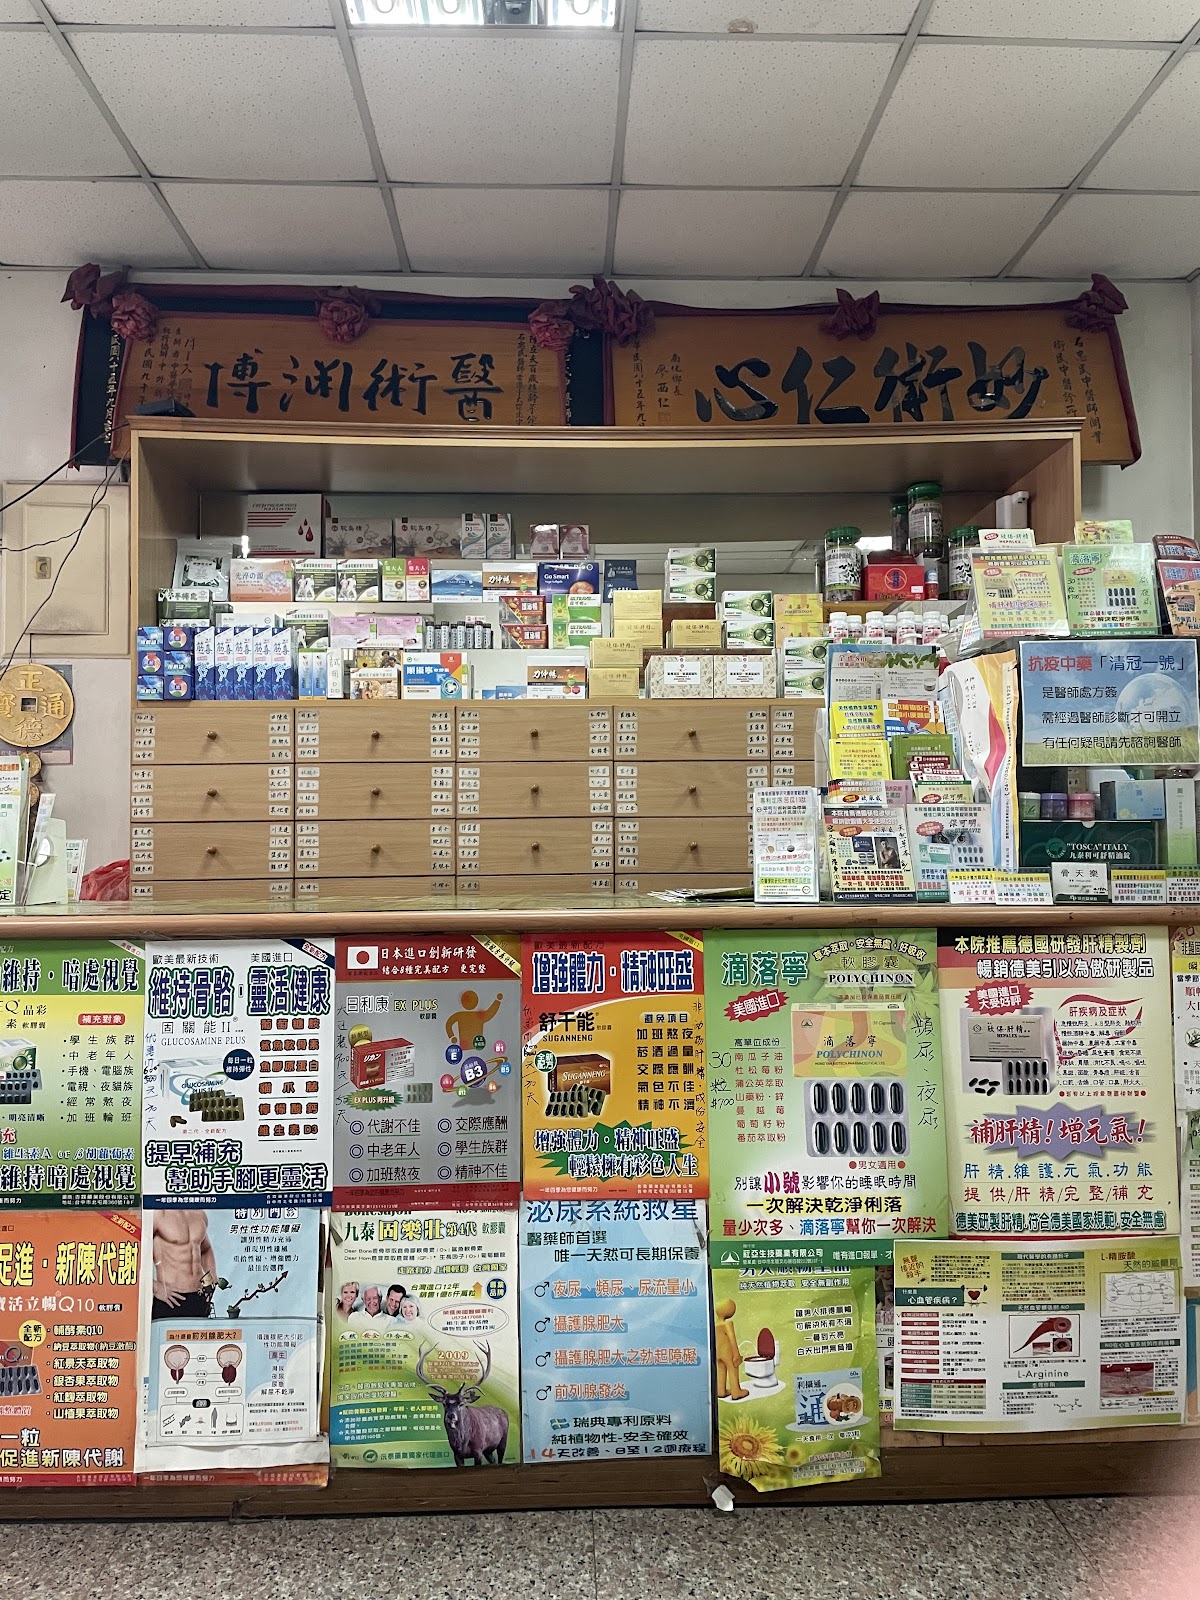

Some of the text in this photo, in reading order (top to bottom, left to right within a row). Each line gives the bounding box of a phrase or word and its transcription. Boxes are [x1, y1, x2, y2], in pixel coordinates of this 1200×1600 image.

[1028, 654, 1185, 672] 抗疫中藥「清冠一號」
[1042, 711, 1182, 724] 需經過醫師診斷才可開立
[1042, 737, 1182, 749] 有任何疑問請先諮詢醫師
[534, 940, 605, 949] 歐美最新配方
[954, 933, 1146, 954] 本院推薦德國研發肝精製劑
[251, 952, 293, 964] 美國進口
[302, 942, 328, 961] 全新配方
[381, 945, 478, 960] 日本進口創新研發
[152, 953, 219, 965] 歐美最新技術
[382, 964, 487, 975] 結合8種完美配方 更完整
[721, 951, 808, 987] 滴落寧
[977, 958, 1154, 979] 暢銷德美引以為傲研製品
[829, 973, 914, 983] POLYCHINON
[977, 985, 1019, 998] 美國進口
[393, 999, 406, 1012] EX
[412, 999, 438, 1011] PLUS
[732, 991, 779, 1018] 美國進口
[979, 996, 1022, 1010] 大受好評
[644, 1013, 688, 1023] 避免項目
[1069, 1006, 1127, 1017] 肝疾病及症狀
[82, 1014, 123, 1025] 補充對象
[260, 1018, 320, 1031] 葡萄糖胺
[161, 1021, 216, 1034] 固關能
[69, 1035, 135, 1045] 學生族群
[161, 1036, 246, 1046] GLUCOSAMINE PLUS
[637, 1028, 694, 1041] 加班熬夜
[259, 1039, 319, 1051] 鯊魚軟骨素
[734, 1038, 780, 1046] 高單位成份
[823, 1035, 877, 1048] 滴落寧
[69, 1050, 134, 1061] 中老年人
[495, 1045, 504, 1053] B1
[637, 1046, 694, 1058] 菸酒過量
[816, 1050, 883, 1059] POLYCHINON
[227, 1056, 254, 1065] 每日一粒
[451, 1052, 457, 1060] E
[709, 1051, 732, 1069] 30
[735, 1052, 783, 1061] 南瓜子油
[67, 1065, 134, 1077] 手機、電腦族
[226, 1066, 253, 1074] 維持彈性
[259, 1060, 319, 1072] 魚膠原蛋白
[464, 1066, 484, 1079] B3
[501, 1065, 510, 1073] B5
[637, 1063, 694, 1076] 交際應酬
[735, 1066, 783, 1074] 杜松莓粉
[67, 1081, 133, 1092] 電視、夜貓族
[259, 1081, 319, 1094] 貓爪藤
[637, 1081, 695, 1093] 氣色不佳
[735, 1079, 784, 1087] 蒲公英萃取
[66, 1096, 133, 1107] 經常熬夜
[637, 1099, 695, 1111] 精神不濟
[258, 1102, 319, 1115] 檸檬酸鈣
[736, 1106, 785, 1115] 蔓越莓
[66, 1112, 132, 1123] 加班輪班
[456, 1116, 508, 1132] 交際應酬
[736, 1119, 785, 1128] 葡萄籽粉
[258, 1123, 319, 1137] 維生素D3
[367, 1118, 420, 1134] 代謝不佳
[737, 1133, 786, 1142] 番茄萃取粉
[146, 1140, 242, 1166] 提早補充
[367, 1143, 420, 1157] 中老年人
[455, 1140, 508, 1155] 學生族群
[568, 1153, 698, 1179] 輕鬆擁有彩色人生
[858, 1160, 896, 1169] 男女適用
[1, 1164, 136, 1191] 維持暗處視覺
[166, 1164, 328, 1192] 幫助手腳更靈活
[367, 1167, 420, 1181] 加班熬夜
[455, 1164, 508, 1180] 精神不佳
[734, 1171, 916, 1194] 別讓小號影響你的睡眠時間
[964, 1185, 1154, 1203] 提供/肝精/完整/補充
[527, 1200, 699, 1223] 泌尿系統救星
[747, 1196, 902, 1214] 一次解決乾淨俐落
[111, 1214, 137, 1234] 全新配方
[229, 1223, 301, 1234] 男性性功能障礙
[723, 1217, 937, 1237] 量少次多、滴落寧幫你一次解決
[345, 1222, 375, 1242] 九泰
[446, 1222, 478, 1236] 第4代
[527, 1230, 607, 1246] 醫藥師首選
[554, 1247, 700, 1263] 唯一天然可長期保養
[1101, 1252, 1136, 1261] L-精胺酸
[553, 1278, 696, 1297] 夜尿、頻尿、尿流量小
[801, 1279, 850, 1288] 安全無副作用
[23, 1324, 42, 1333] 全新
[554, 1315, 624, 1332] 攝護腺肥大
[23, 1333, 42, 1342] 配方
[805, 1332, 844, 1342] 一覺到天亮
[438, 1350, 469, 1360] 2009
[797, 1343, 853, 1355] 白天出門無負擔
[554, 1348, 697, 1366] 攝護腺肥大之勃起障礙
[53, 1358, 119, 1370] 紅景天萃取物
[53, 1375, 119, 1387] 銀杏果萃取物
[1018, 1370, 1069, 1379] L-Arginine
[555, 1384, 626, 1399] 前列腺發炎
[573, 1414, 672, 1428] 瑞典專利原料
[551, 1430, 689, 1445] 純植物性-安全確效
[0, 1448, 124, 1468] 促進新陳代謝
